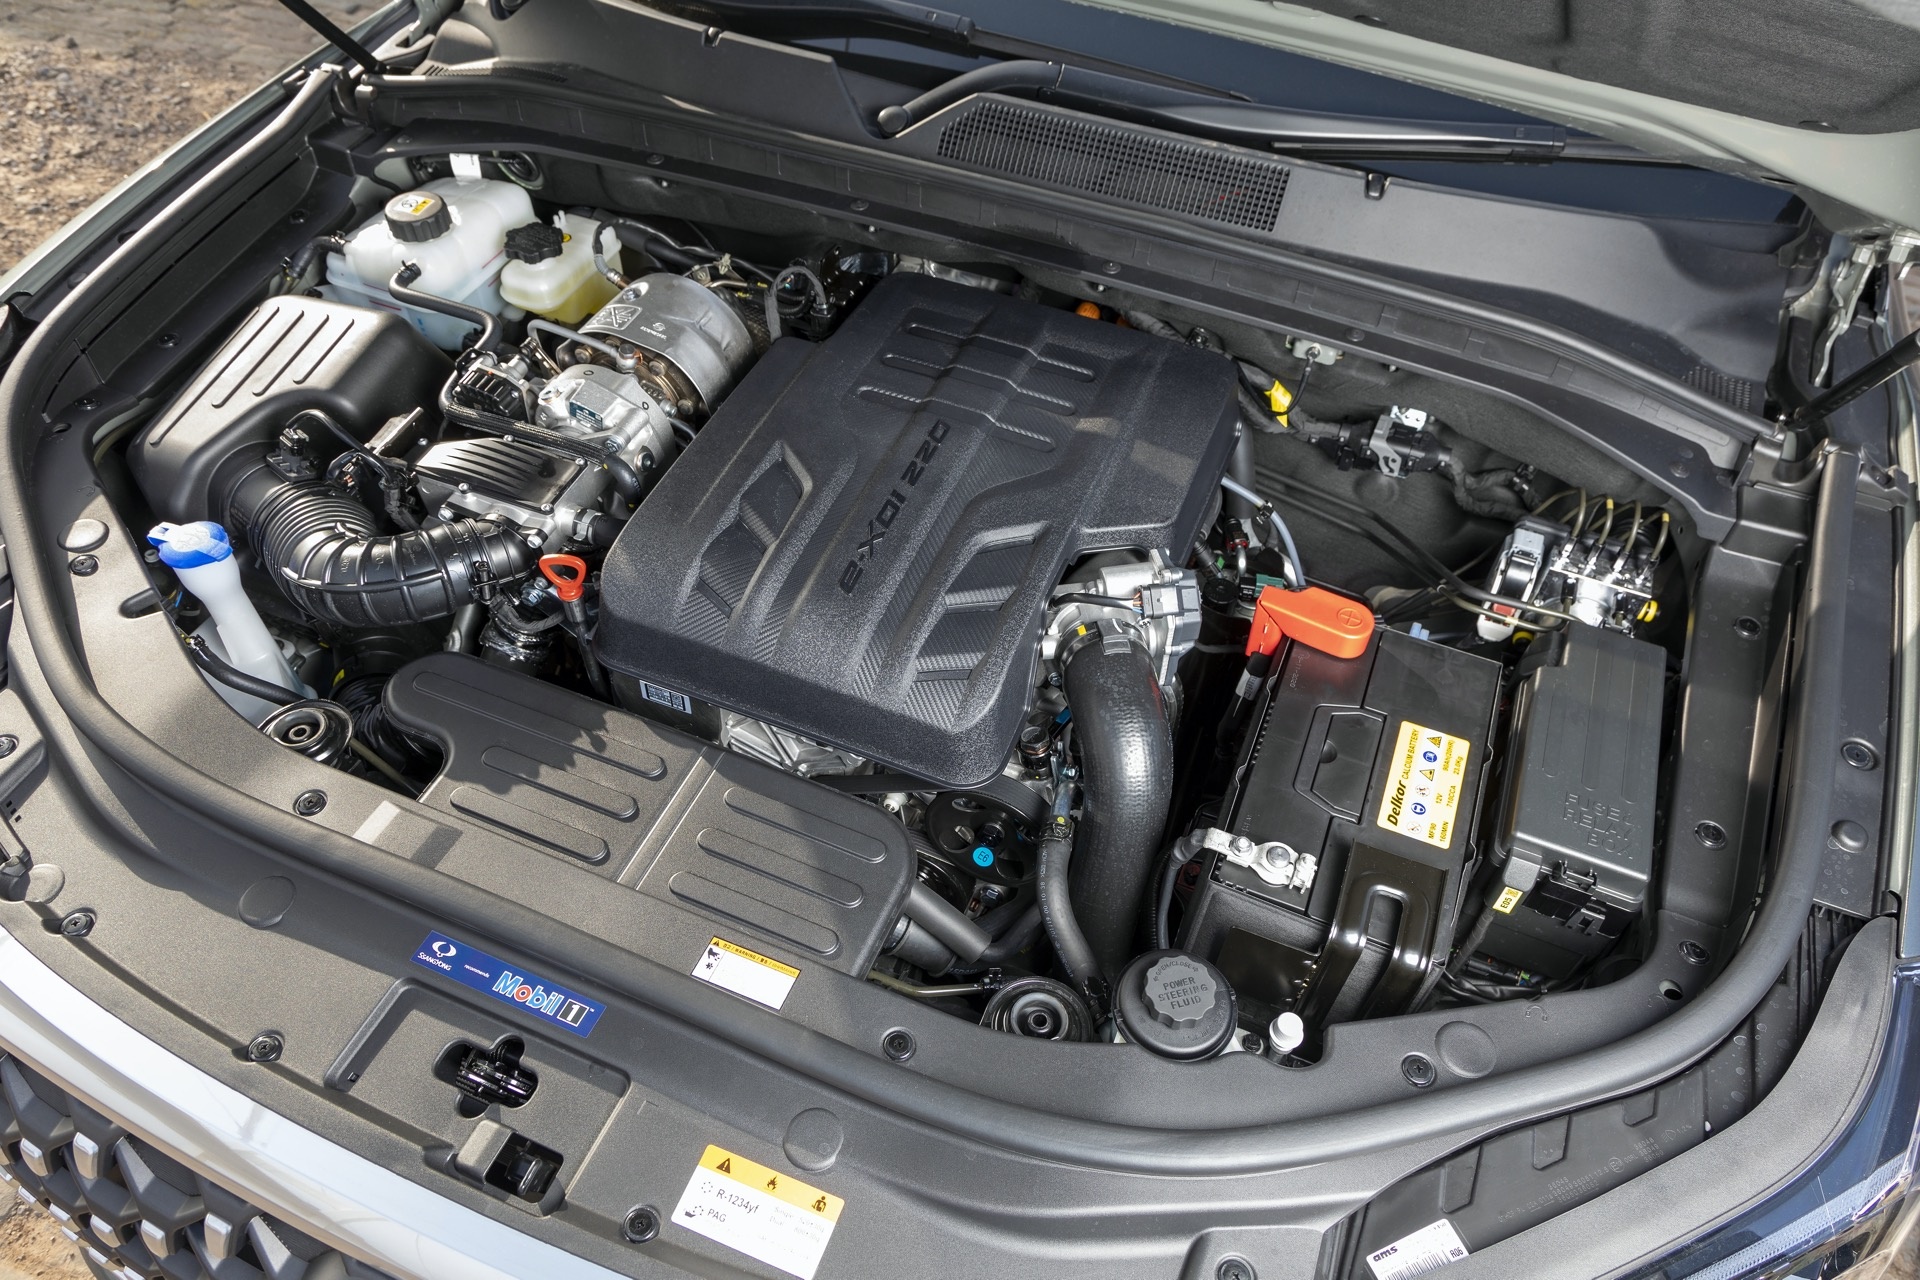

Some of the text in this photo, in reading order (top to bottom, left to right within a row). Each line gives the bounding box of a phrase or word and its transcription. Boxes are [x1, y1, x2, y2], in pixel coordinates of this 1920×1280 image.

[900, 419, 952, 487] 220
[1387, 728, 1419, 827] Delkor CALCIUM BATTERY
[1563, 807, 1632, 841] RELAY
[1587, 832, 1634, 860] BOX
[977, 850, 990, 863] E6
[1500, 897, 1513, 909] E05
[417, 952, 452, 971] SSANGYONG
[1163, 976, 1196, 991] POWER
[492, 970, 565, 1016] Mobil
[1158, 984, 1208, 1002] STEERING
[1170, 995, 1202, 1010] FLUID
[716, 1188, 760, 1215] R-1234yf
[707, 1208, 727, 1223] PAG
[1373, 1245, 1398, 1262] ams
[1449, 1247, 1464, 1259] R06
